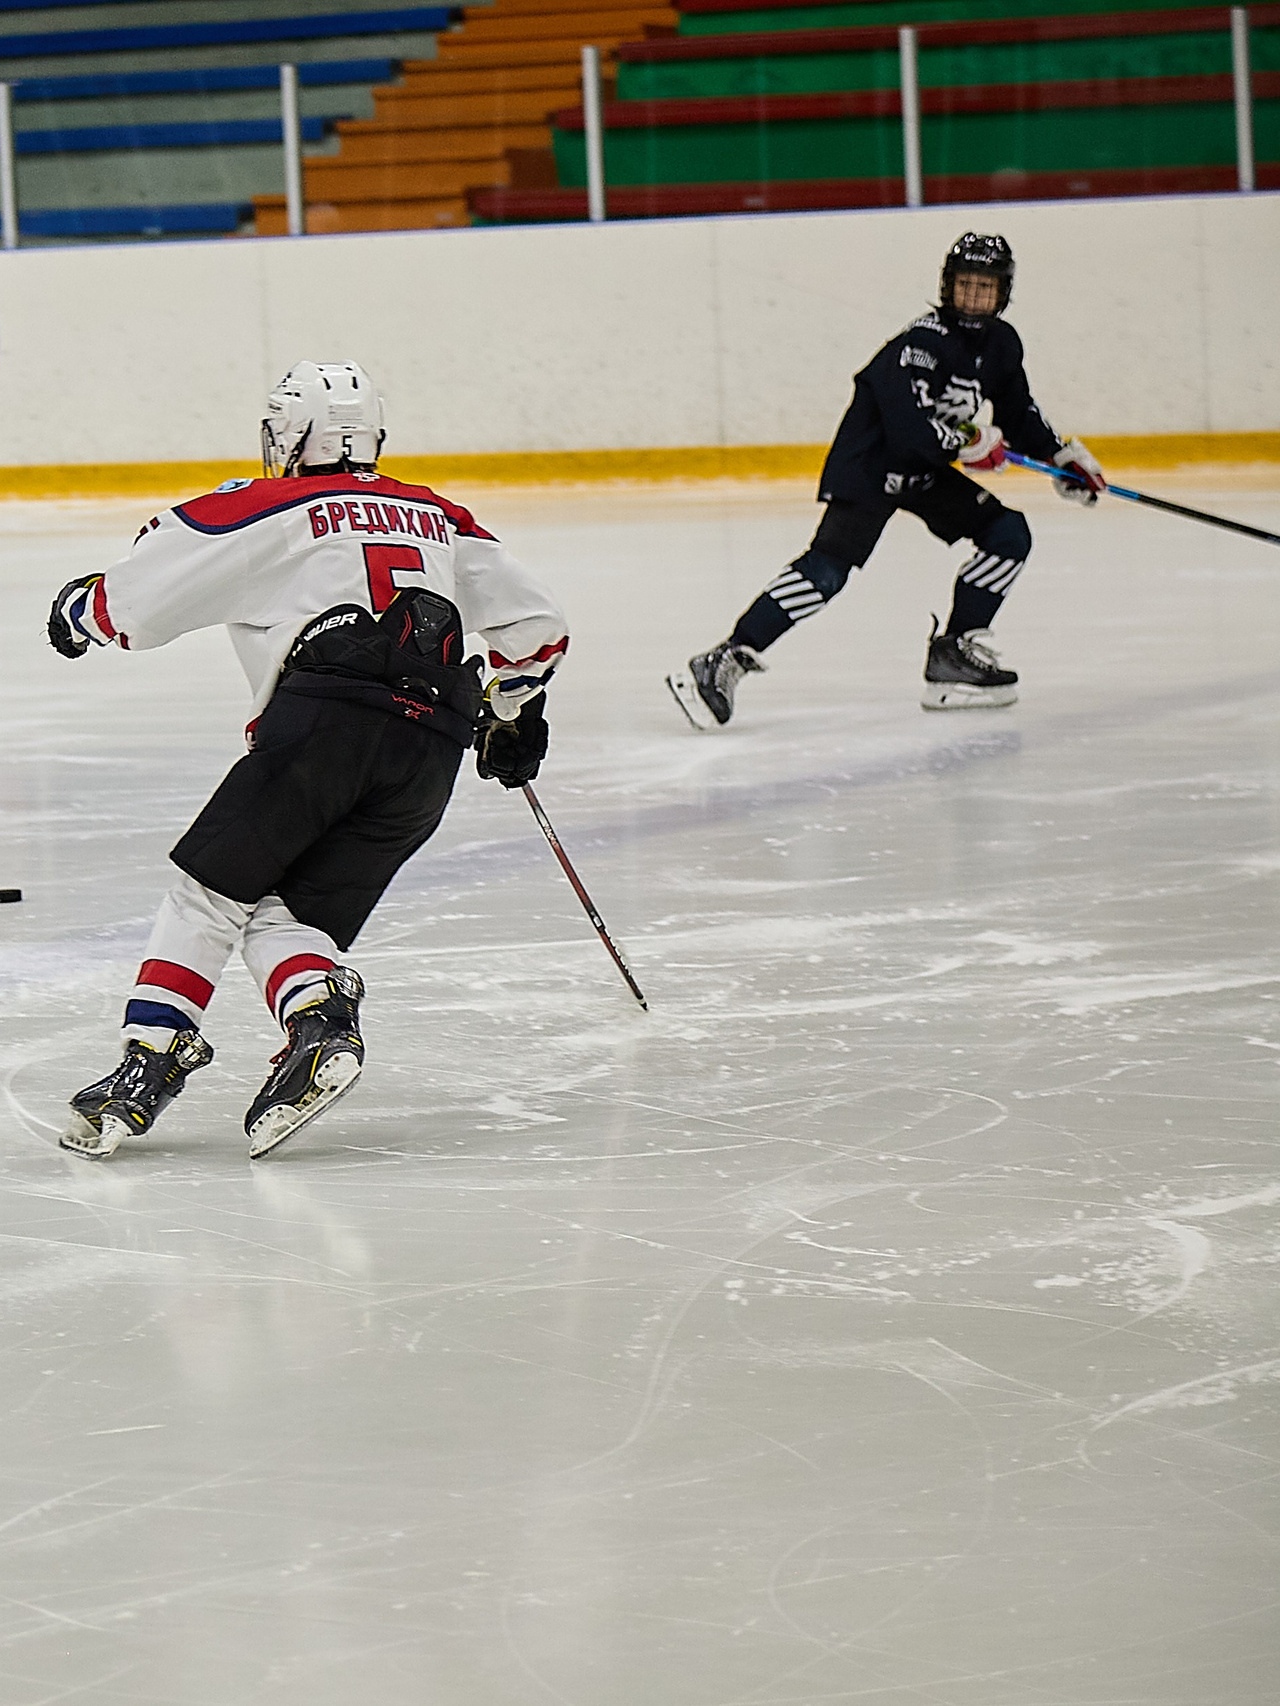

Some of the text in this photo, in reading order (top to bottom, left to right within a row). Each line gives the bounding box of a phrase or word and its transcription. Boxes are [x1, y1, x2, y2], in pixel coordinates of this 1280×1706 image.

[342, 434, 353, 457] 5
[307, 501, 450, 545] БРЕДИХИН
[391, 693, 434, 716] VAPOR
